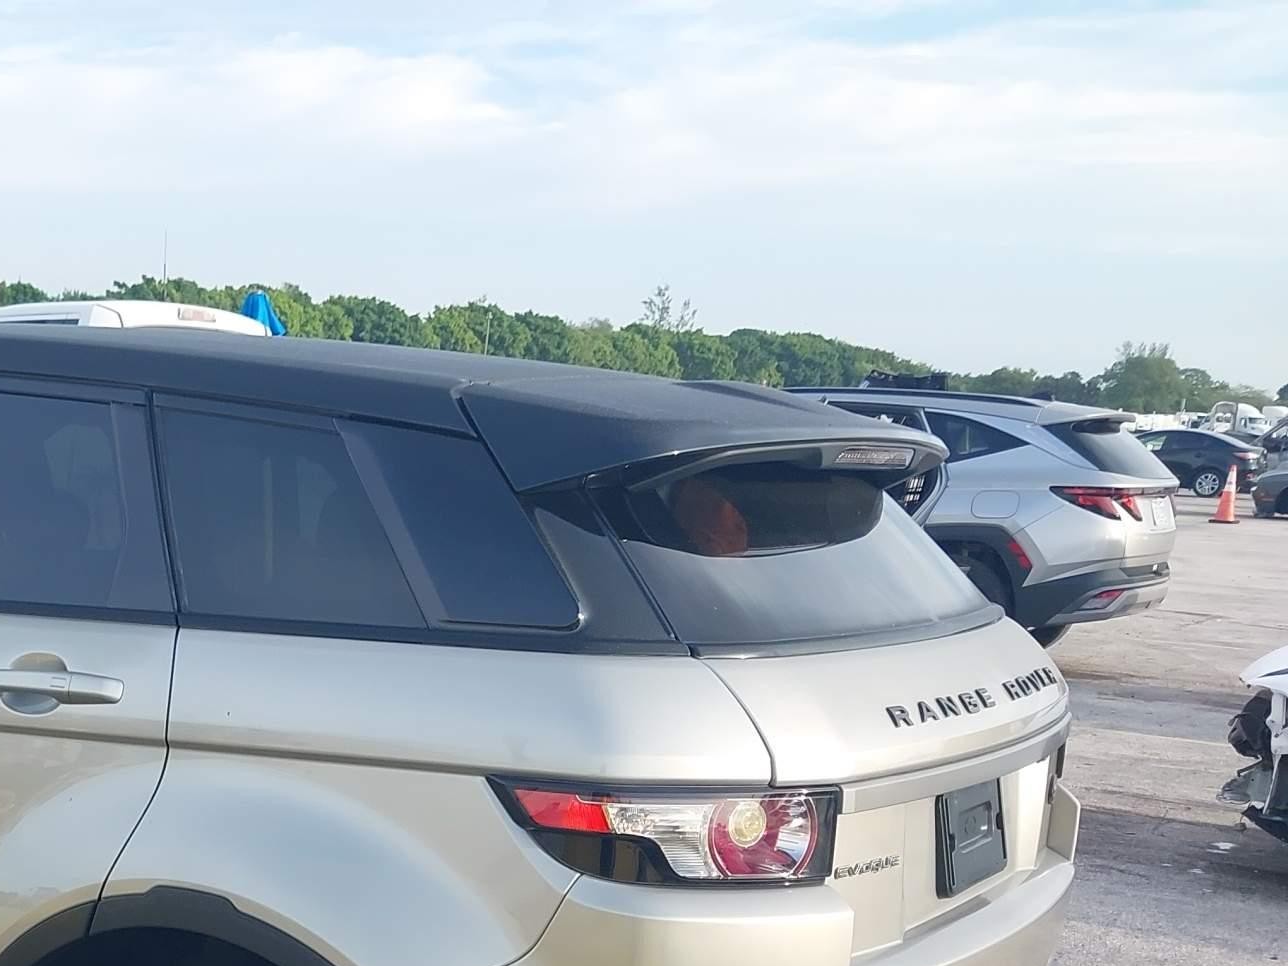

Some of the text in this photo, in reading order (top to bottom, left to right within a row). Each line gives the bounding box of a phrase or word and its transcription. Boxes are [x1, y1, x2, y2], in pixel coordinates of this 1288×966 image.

[886, 666, 1058, 728] RANGE ROVER
[834, 855, 900, 880] EVOQUE
